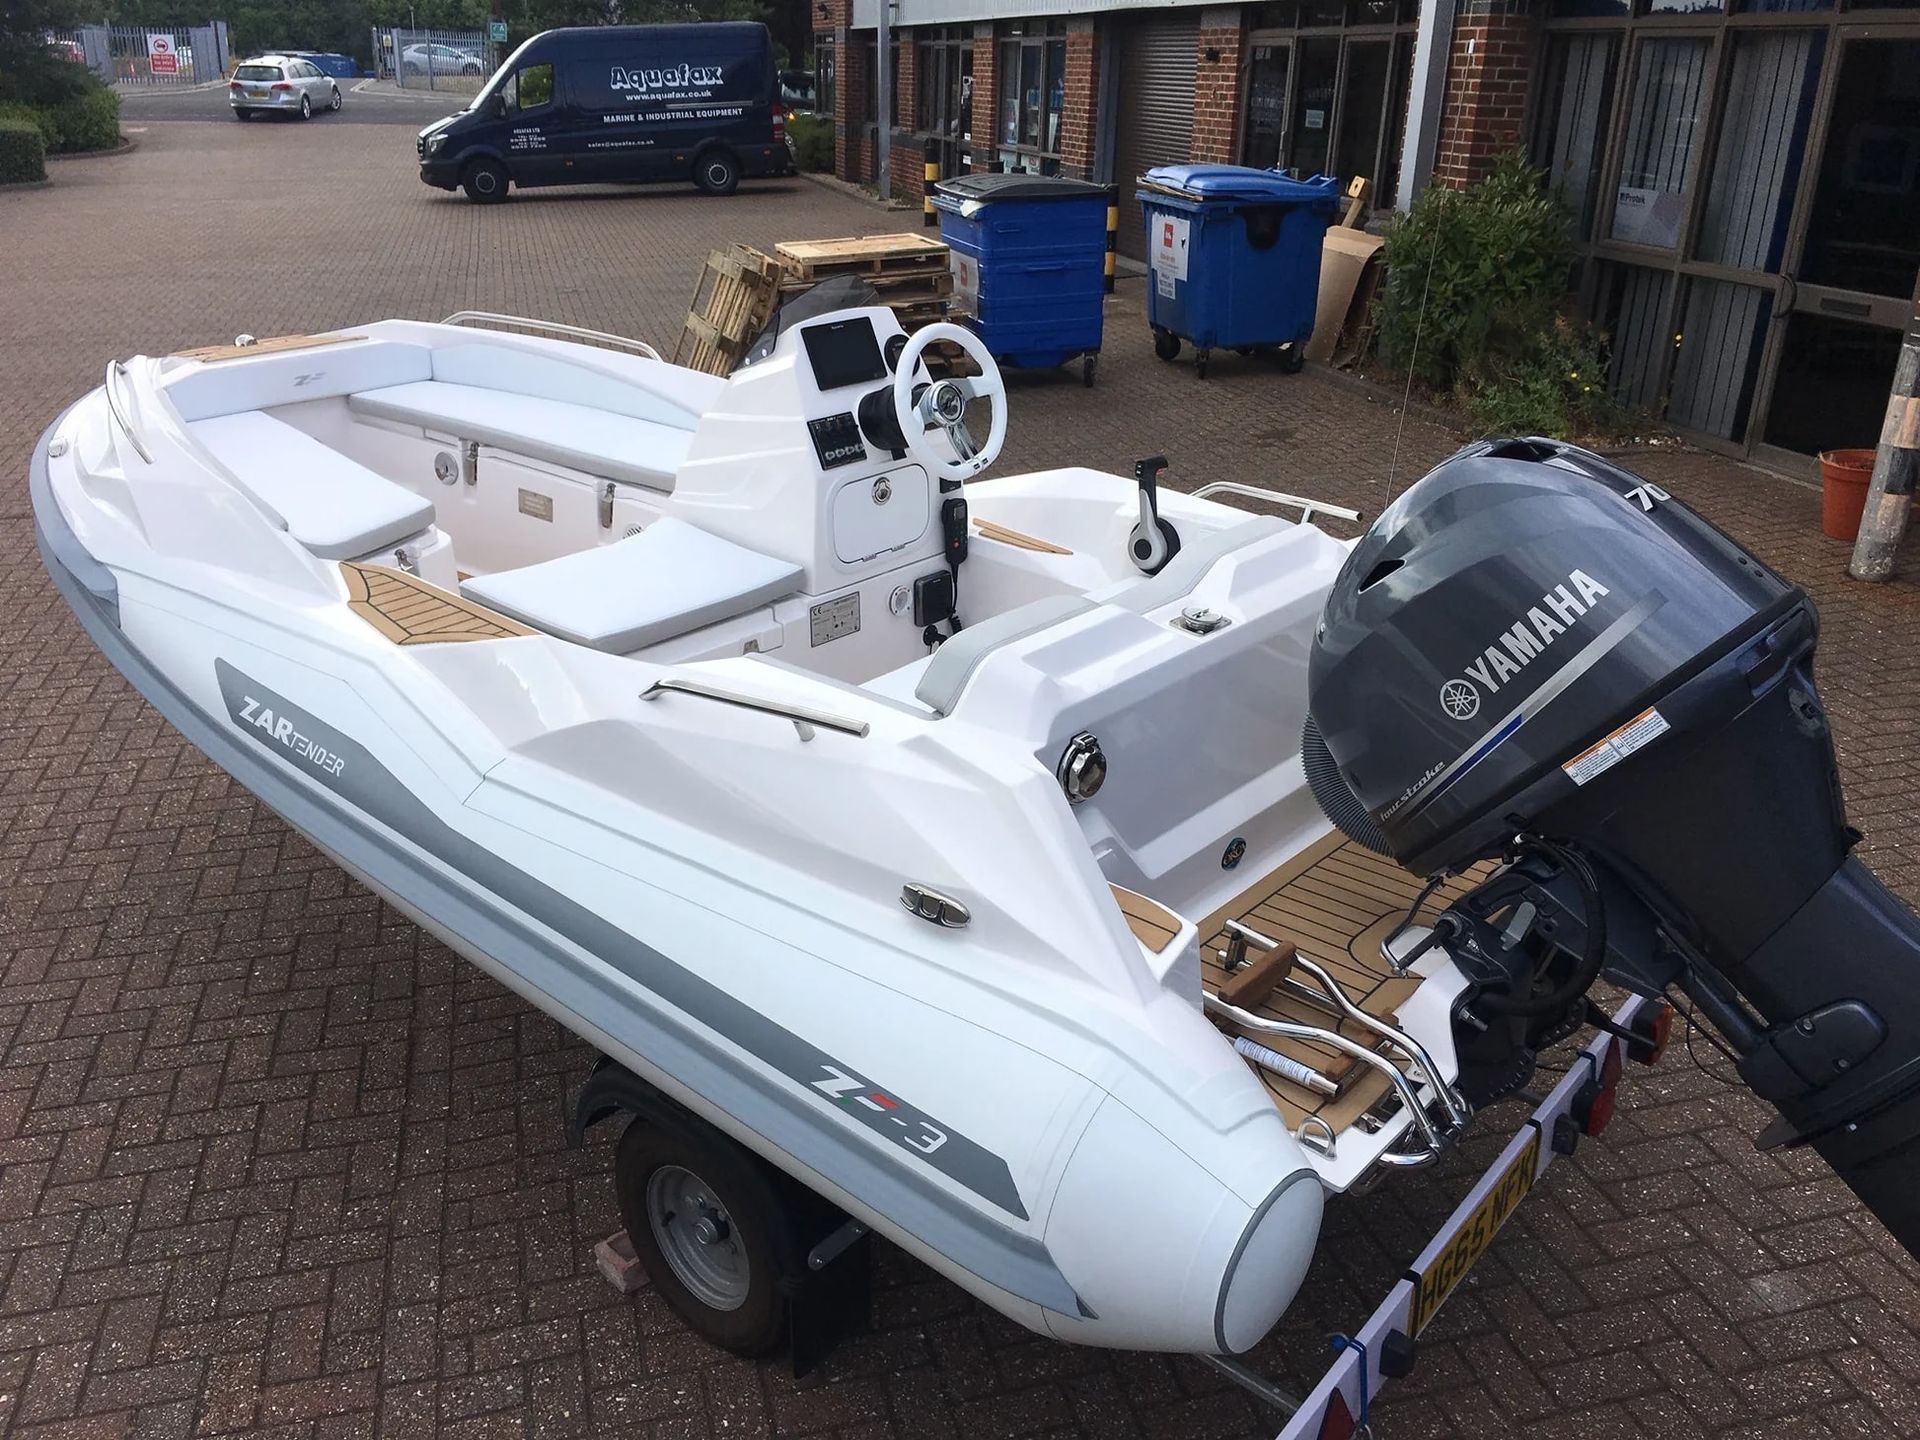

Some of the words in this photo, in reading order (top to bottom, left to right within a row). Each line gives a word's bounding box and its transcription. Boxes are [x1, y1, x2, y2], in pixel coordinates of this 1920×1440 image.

[610, 63, 724, 92] Aquafax
[625, 89, 712, 101] www.aquafax.co.uk
[603, 114, 636, 123] MARINE
[638, 113, 645, 121] &
[645, 111, 695, 121] INDUSTRIAL
[696, 108, 743, 119] EQUIPMENT
[1623, 483, 1672, 511] 70
[1464, 568, 1610, 693] YAMAHA
[1419, 1207, 1487, 1324] HG65
